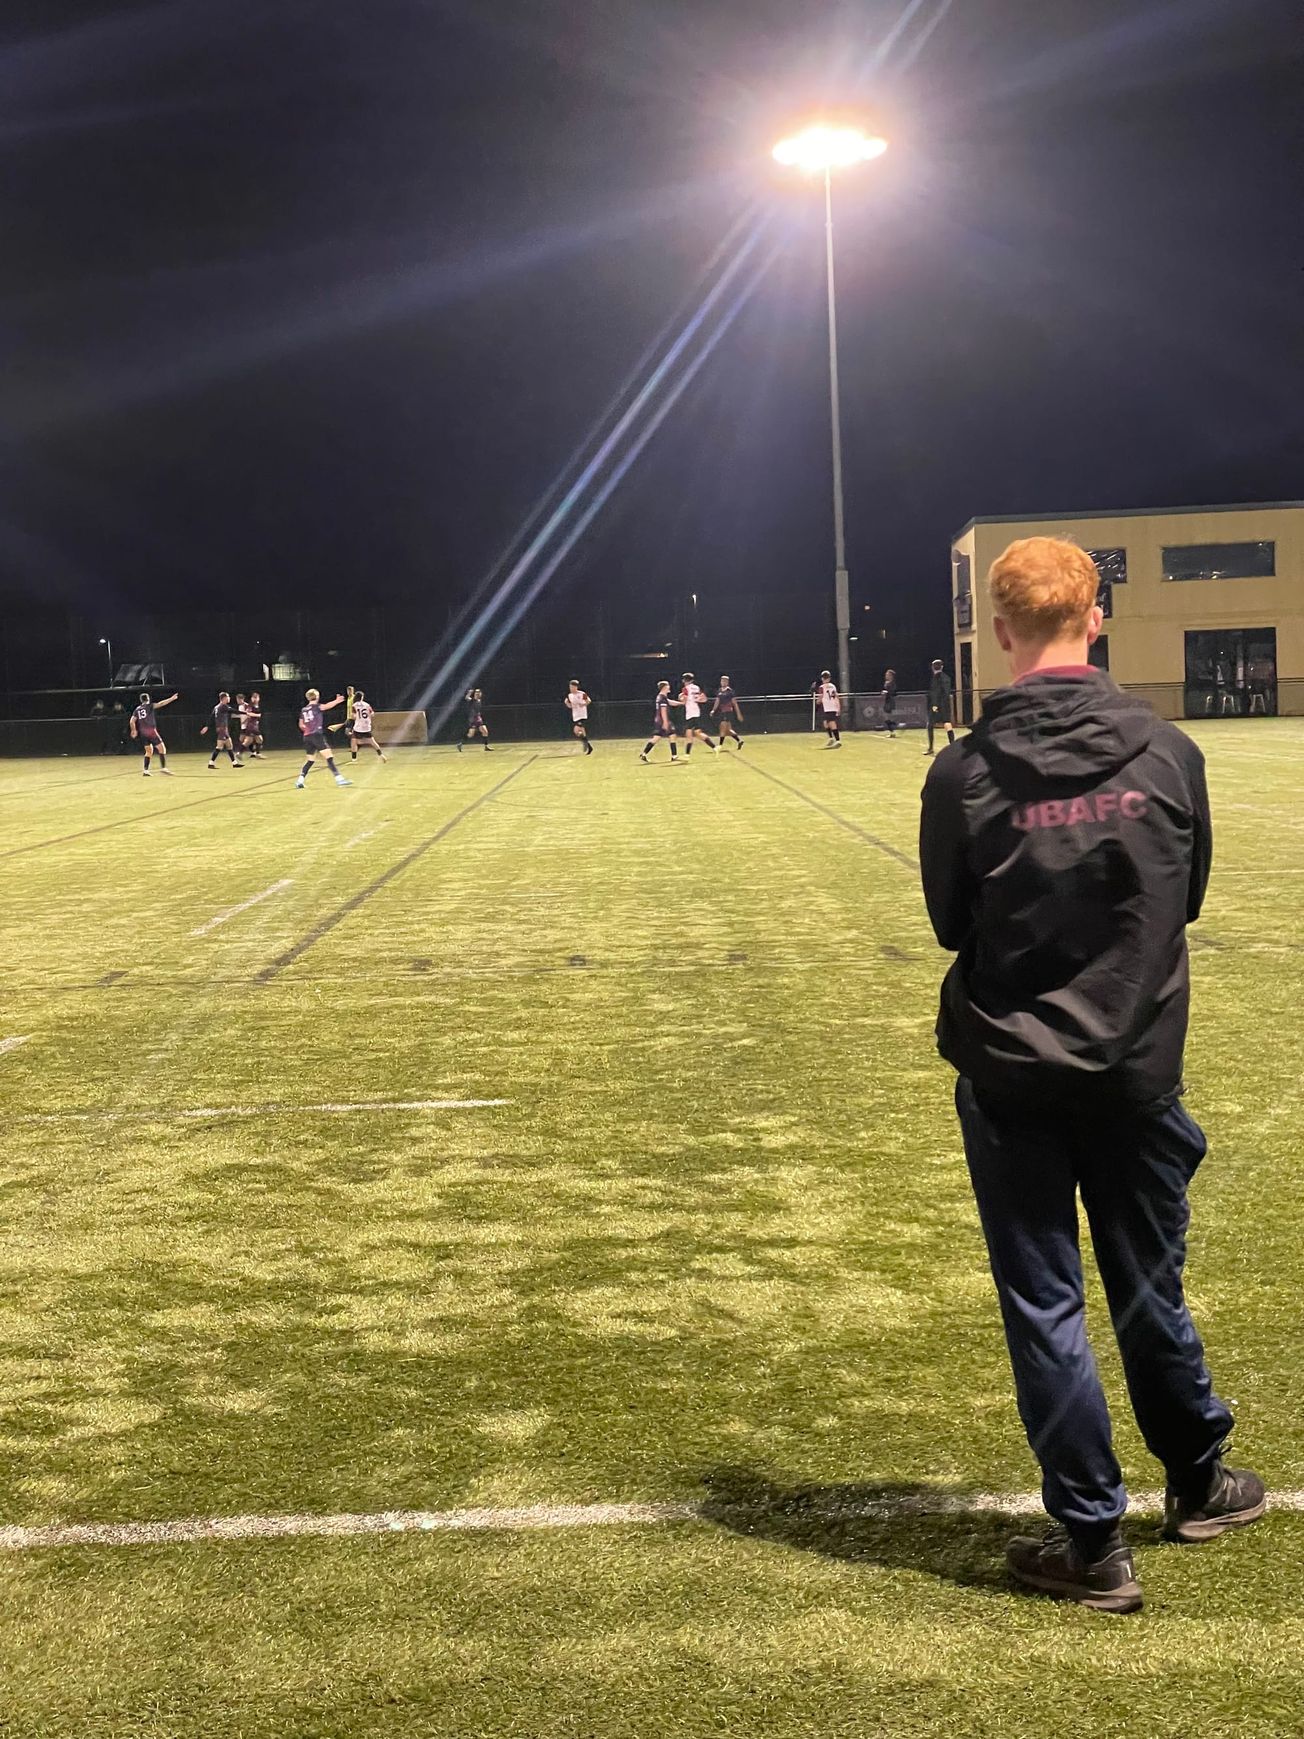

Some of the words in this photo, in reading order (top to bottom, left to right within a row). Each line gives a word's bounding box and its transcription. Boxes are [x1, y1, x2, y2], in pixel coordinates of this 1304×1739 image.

[137, 708, 147, 720] 13
[357, 708, 368, 719] 16
[1010, 790, 1148, 832] UBAFC
